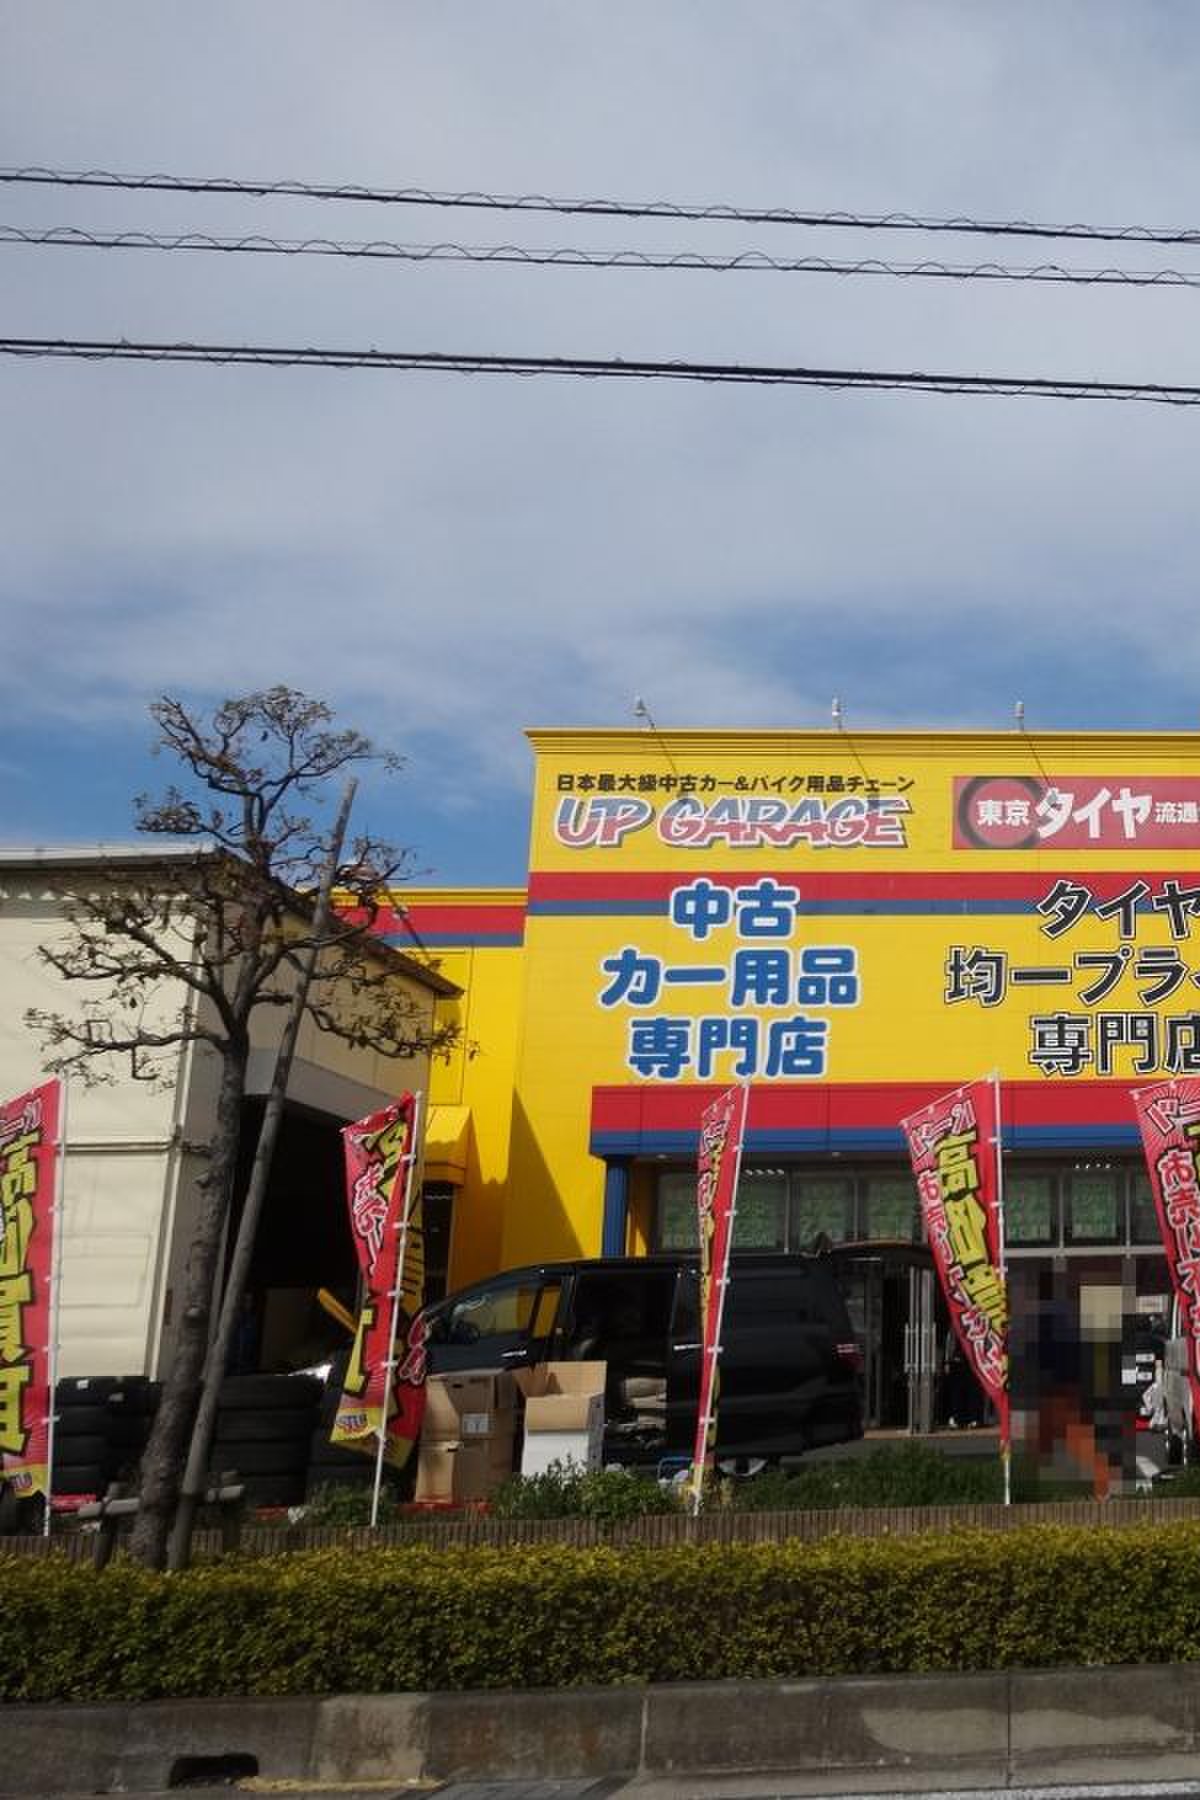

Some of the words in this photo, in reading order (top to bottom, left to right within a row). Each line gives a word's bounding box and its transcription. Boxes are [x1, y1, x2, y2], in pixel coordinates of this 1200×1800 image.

[555, 795, 655, 848] UP
[657, 795, 914, 849] GARAGE
[671, 878, 800, 939] 中古
[598, 946, 859, 1008] カー用品
[628, 1014, 828, 1079] 専門店
